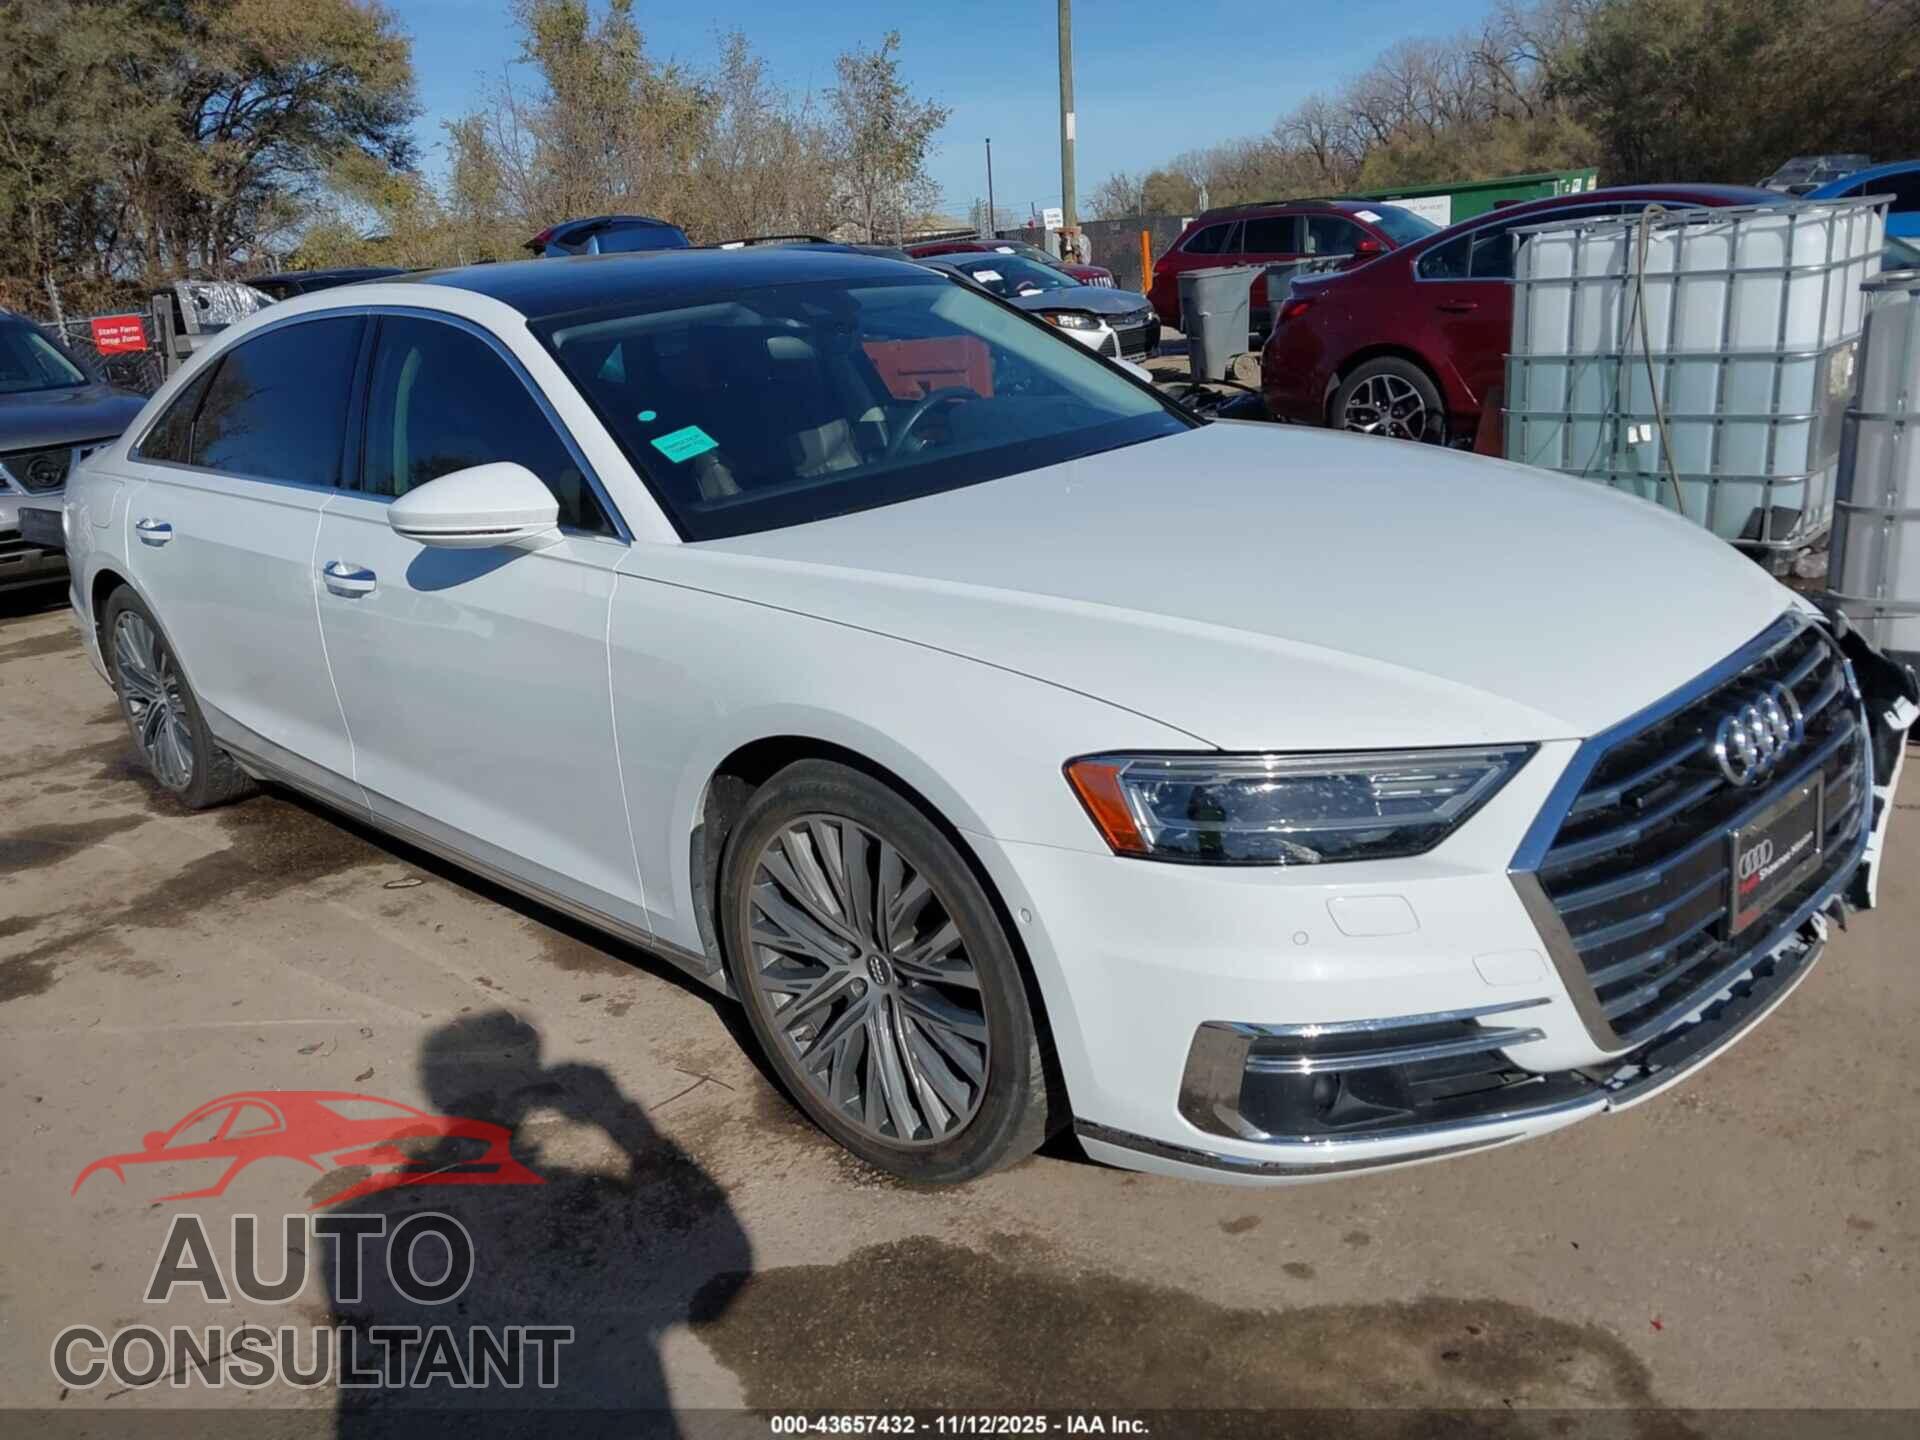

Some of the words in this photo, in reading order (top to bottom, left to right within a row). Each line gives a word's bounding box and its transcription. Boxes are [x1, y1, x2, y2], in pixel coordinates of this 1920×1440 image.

[97, 327, 118, 336] State
[100, 337, 120, 345] Drop
[121, 335, 141, 343] Zone
